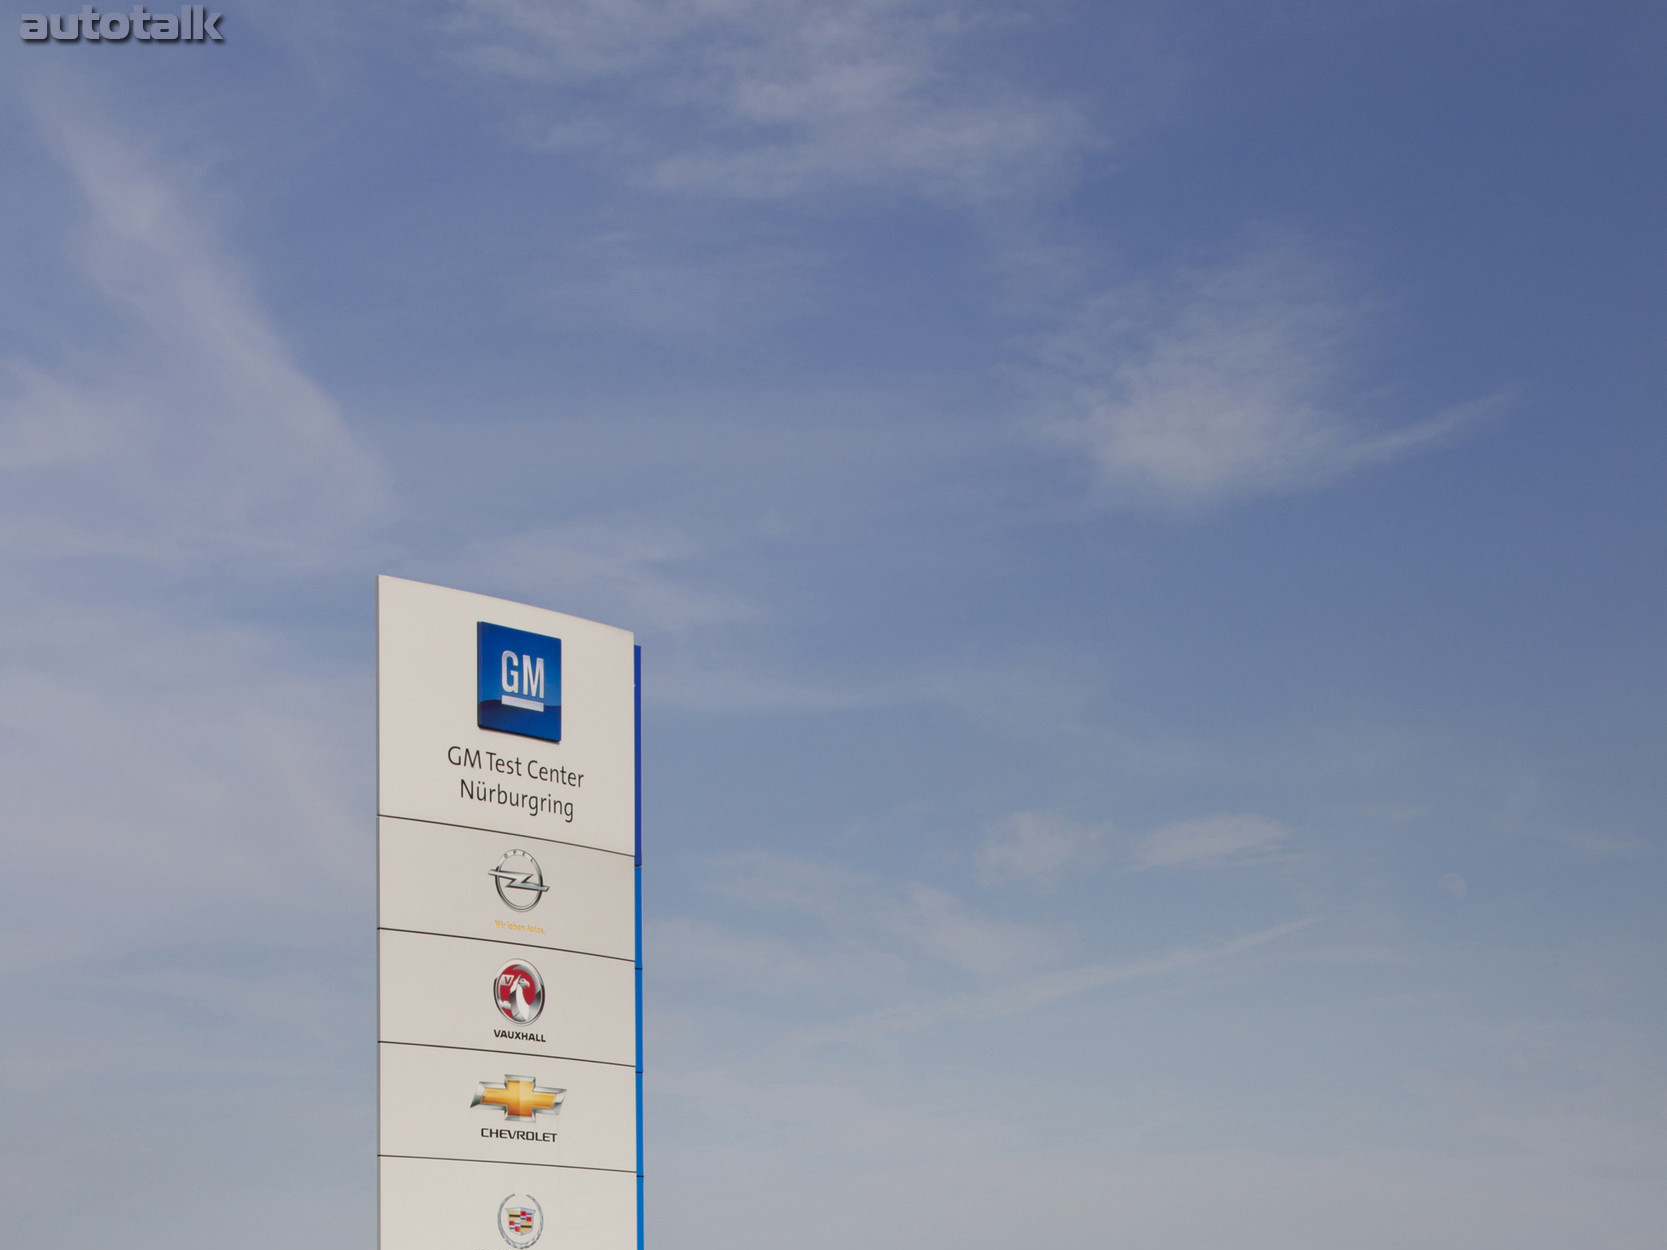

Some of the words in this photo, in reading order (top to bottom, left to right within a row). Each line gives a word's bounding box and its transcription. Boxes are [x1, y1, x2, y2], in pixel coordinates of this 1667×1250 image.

[501, 650, 545, 699] GM
[447, 745, 482, 770] GM
[485, 751, 522, 777] Test
[527, 760, 584, 788] Center
[460, 778, 575, 823] Nürburgring
[493, 1028, 546, 1043] VAUXHALL
[480, 1127, 558, 1143] CHEVROLET
